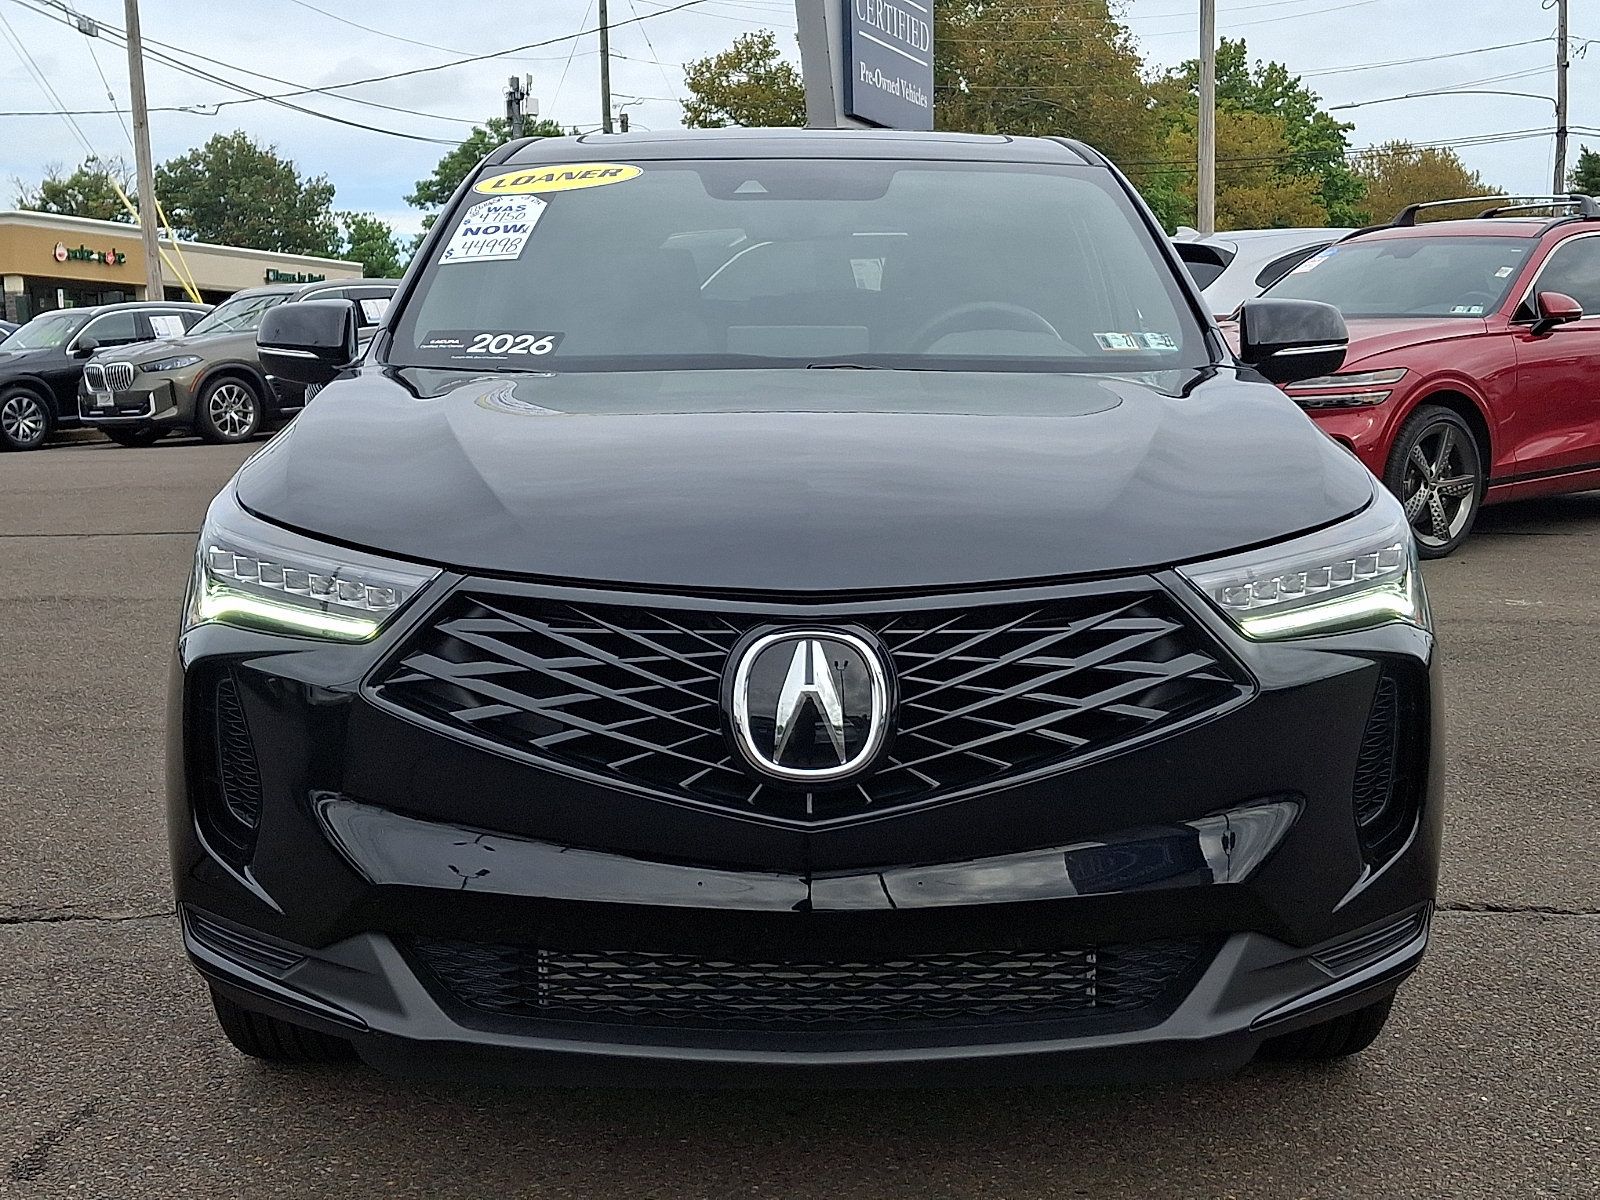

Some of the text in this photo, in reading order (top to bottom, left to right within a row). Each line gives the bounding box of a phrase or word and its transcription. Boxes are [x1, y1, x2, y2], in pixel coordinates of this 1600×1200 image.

[856, 0, 929, 52] CERTIFIED
[860, 61, 928, 108] Pre-Owned Vehicles
[491, 168, 624, 189] LOANER
[487, 204, 527, 213] WAS
[444, 237, 522, 259] $ 44998
[466, 333, 555, 355] 2026
